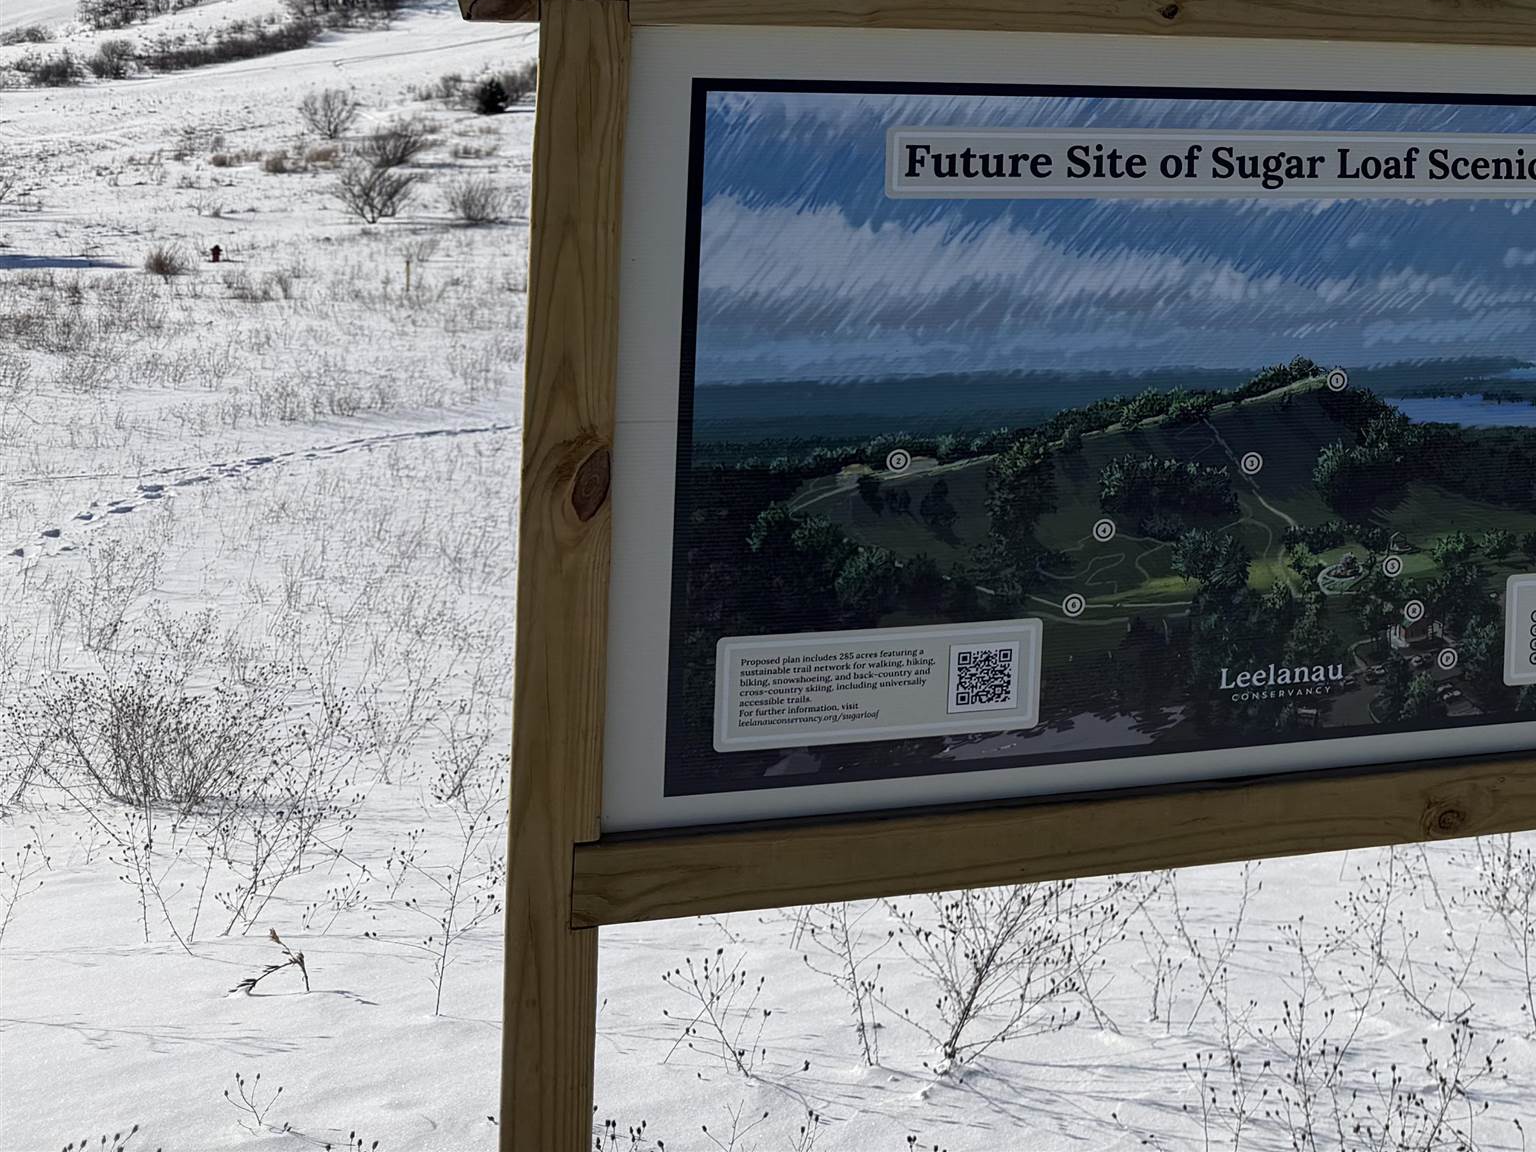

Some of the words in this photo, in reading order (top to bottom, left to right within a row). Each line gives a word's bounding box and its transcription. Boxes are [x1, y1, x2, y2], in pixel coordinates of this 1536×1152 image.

[904, 144, 1053, 179] Future
[1066, 143, 1148, 179] Site
[1159, 145, 1203, 179] of
[1211, 146, 1325, 190] Sugar
[1337, 147, 1420, 180] Loaf
[741, 657, 781, 667] Proposed
[782, 655, 800, 665] plan
[803, 654, 837, 663] includes
[879, 649, 918, 659] featuring
[740, 666, 790, 677] sustainable
[793, 665, 811, 674] trail
[814, 663, 851, 672] network
[853, 661, 866, 670] for
[835, 672, 852, 681] and
[853, 668, 912, 680] back-country
[914, 668, 931, 676] and
[1220, 663, 1344, 689] Leelanau
[739, 686, 803, 697] cross-country
[836, 681, 877, 691] including
[879, 677, 927, 688] universally
[1231, 686, 1331, 702] CONSERVANCY
[739, 697, 784, 707] accessible
[787, 696, 811, 705] trails.
[739, 709, 753, 718] For
[755, 706, 786, 716] further
[841, 702, 860, 710] visit
[738, 709, 880, 727] leelanauconservancy.org/sugarloaf
